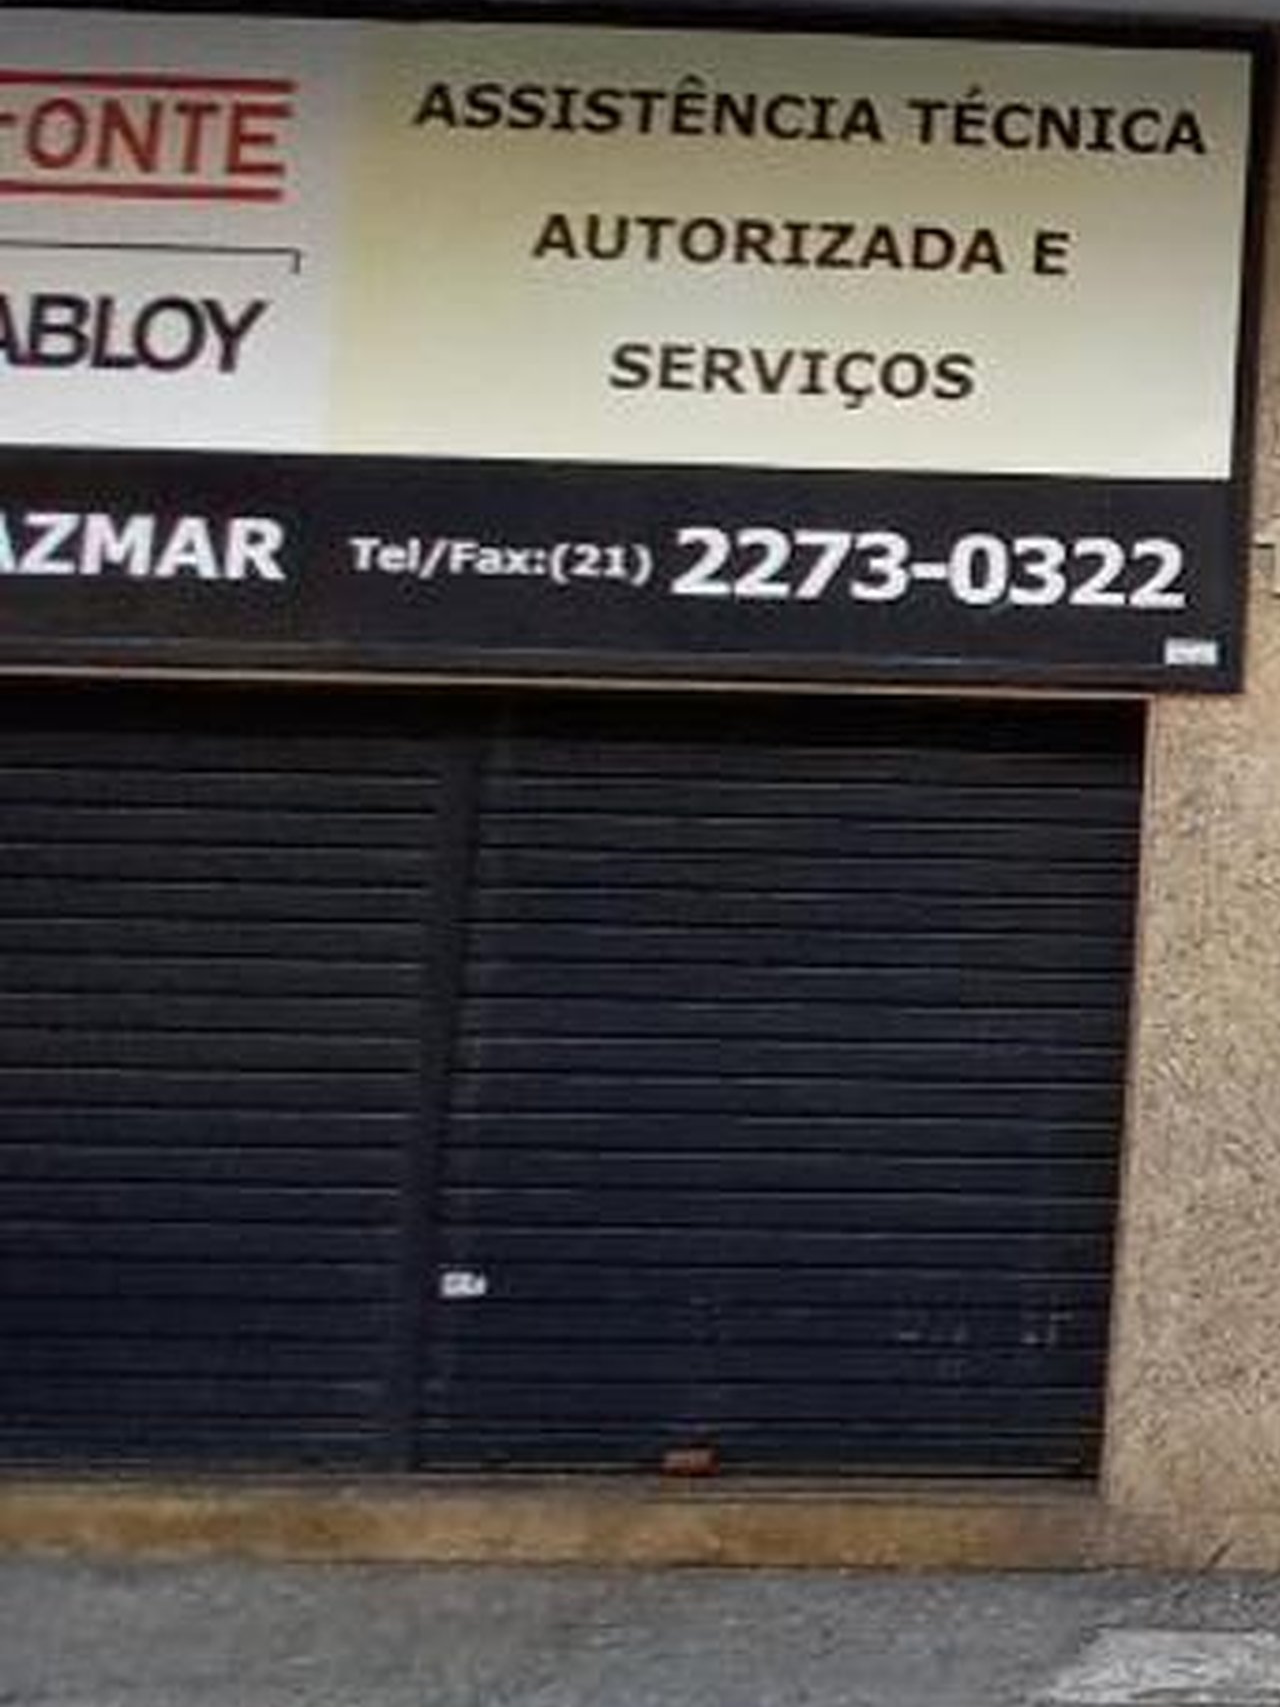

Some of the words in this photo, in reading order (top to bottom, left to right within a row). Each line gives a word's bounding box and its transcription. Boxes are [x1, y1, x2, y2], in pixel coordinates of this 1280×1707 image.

[414, 75, 884, 145] ASSISTÊNCIA
[909, 87, 1207, 155] TÉCNICA
[531, 213, 1005, 276] AUTORIZADA
[1033, 229, 1071, 276] E
[608, 343, 976, 410] SERVIÇOS
[0, 511, 286, 581] ZMAR
[349, 537, 654, 586] Tel/Fax:(21)
[671, 527, 1187, 609] 2273-0322
